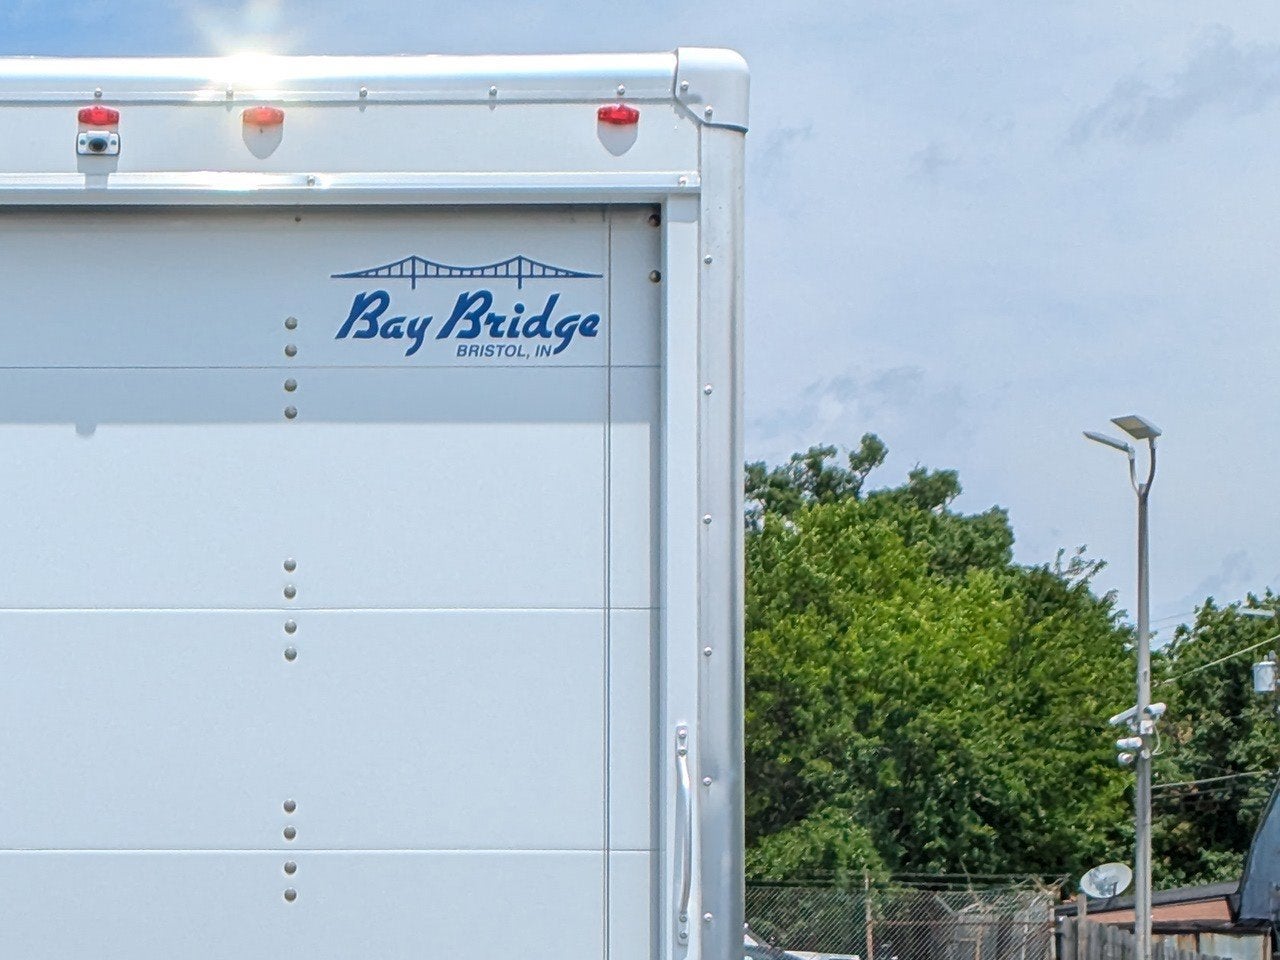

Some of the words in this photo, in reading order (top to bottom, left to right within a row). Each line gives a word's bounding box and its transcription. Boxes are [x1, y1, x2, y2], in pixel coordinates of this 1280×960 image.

[334, 289, 433, 357] Bay
[435, 289, 601, 356] Bridge
[456, 344, 530, 359] BRISTOL,
[535, 344, 553, 357] IN
